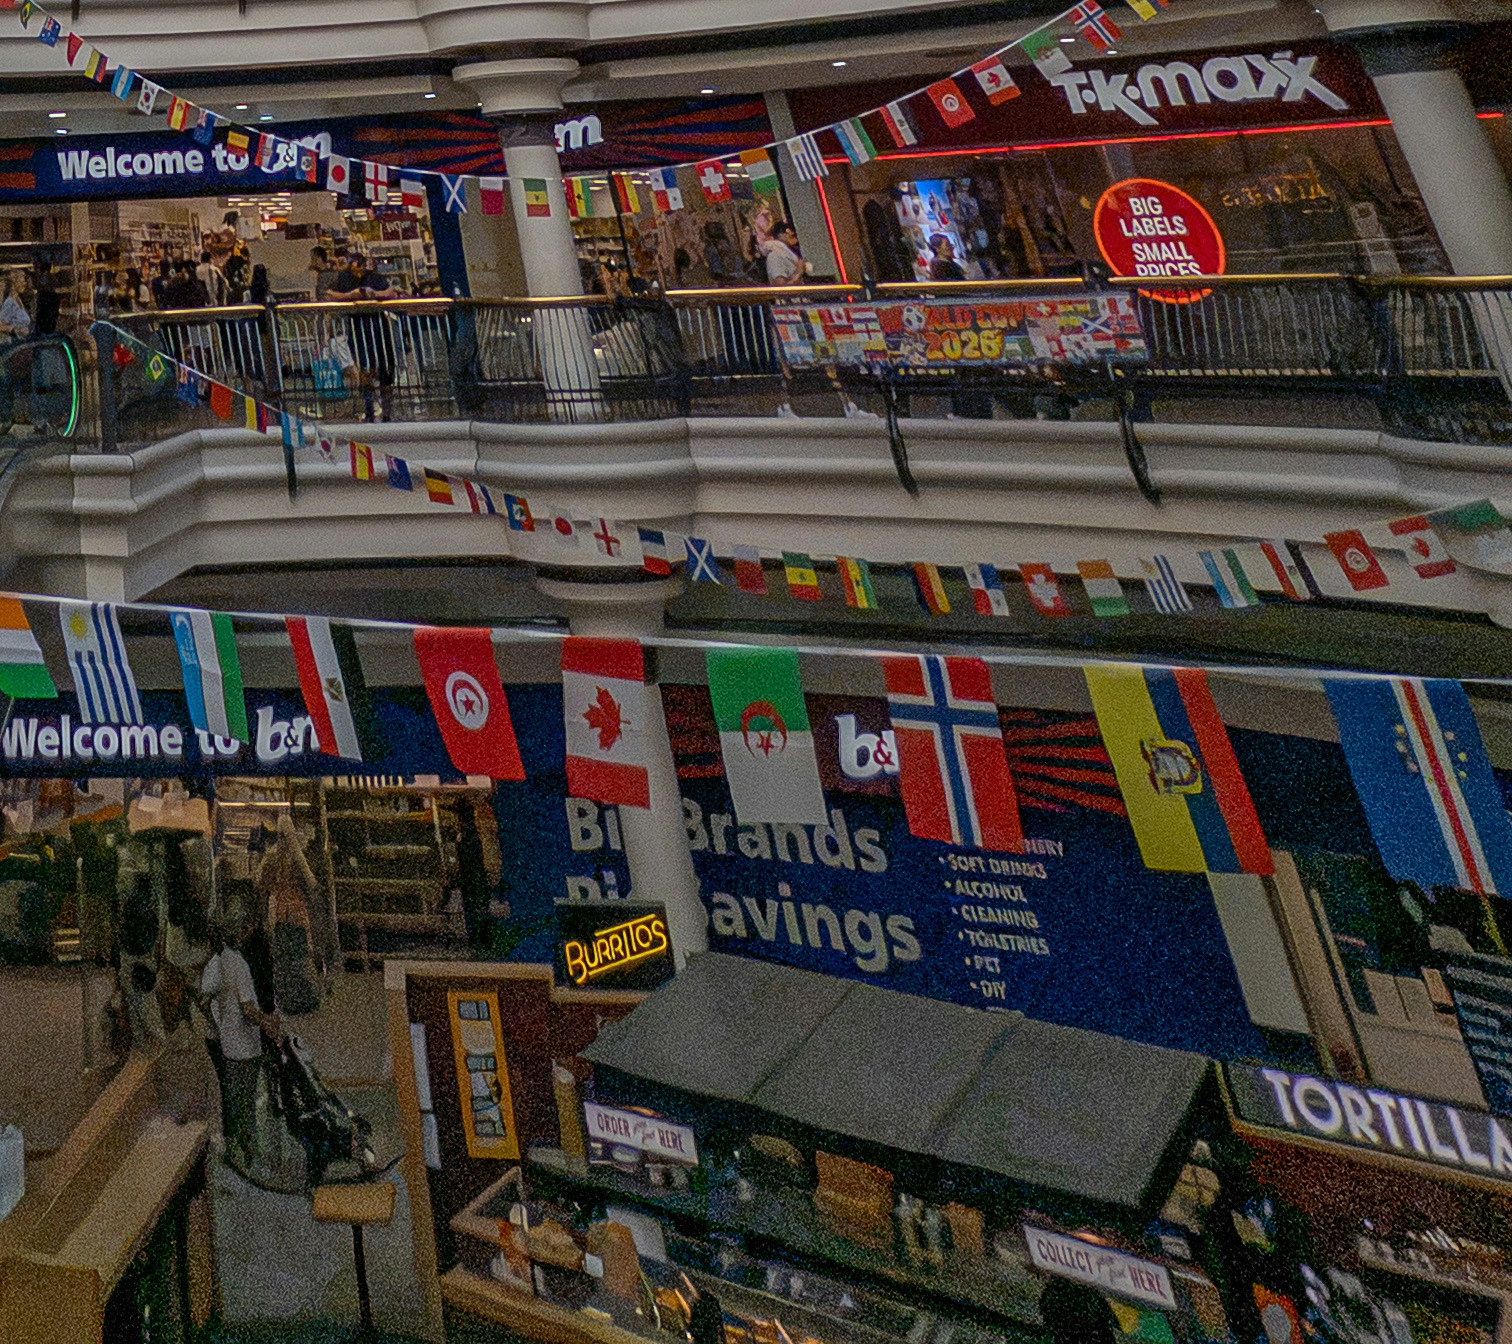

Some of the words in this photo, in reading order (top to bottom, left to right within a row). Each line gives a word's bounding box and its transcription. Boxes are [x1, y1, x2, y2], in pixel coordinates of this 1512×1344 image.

[57, 146, 204, 181] Welcome
[211, 142, 250, 173] to
[1128, 196, 1163, 216] BIG
[1119, 215, 1187, 238] LABELS
[1131, 241, 1194, 262] SMALL
[925, 330, 1005, 361] 2026
[2, 714, 183, 759] Welcome
[565, 796, 623, 853] Bi
[682, 796, 888, 874] Brands
[947, 853, 986, 874] SOFT
[955, 879, 1028, 903] ALCOHOL
[711, 880, 922, 973] avings
[961, 904, 1039, 929] CLEANING
[565, 916, 668, 985] BURRITOS
[974, 954, 1002, 974] PET
[596, 1112, 631, 1139] ORDER
[657, 1127, 686, 1154] HERE
[1261, 1067, 1512, 1174] TORTILLA
[1036, 1238, 1094, 1275] COLLECT
[1127, 1264, 1168, 1301] HERE
